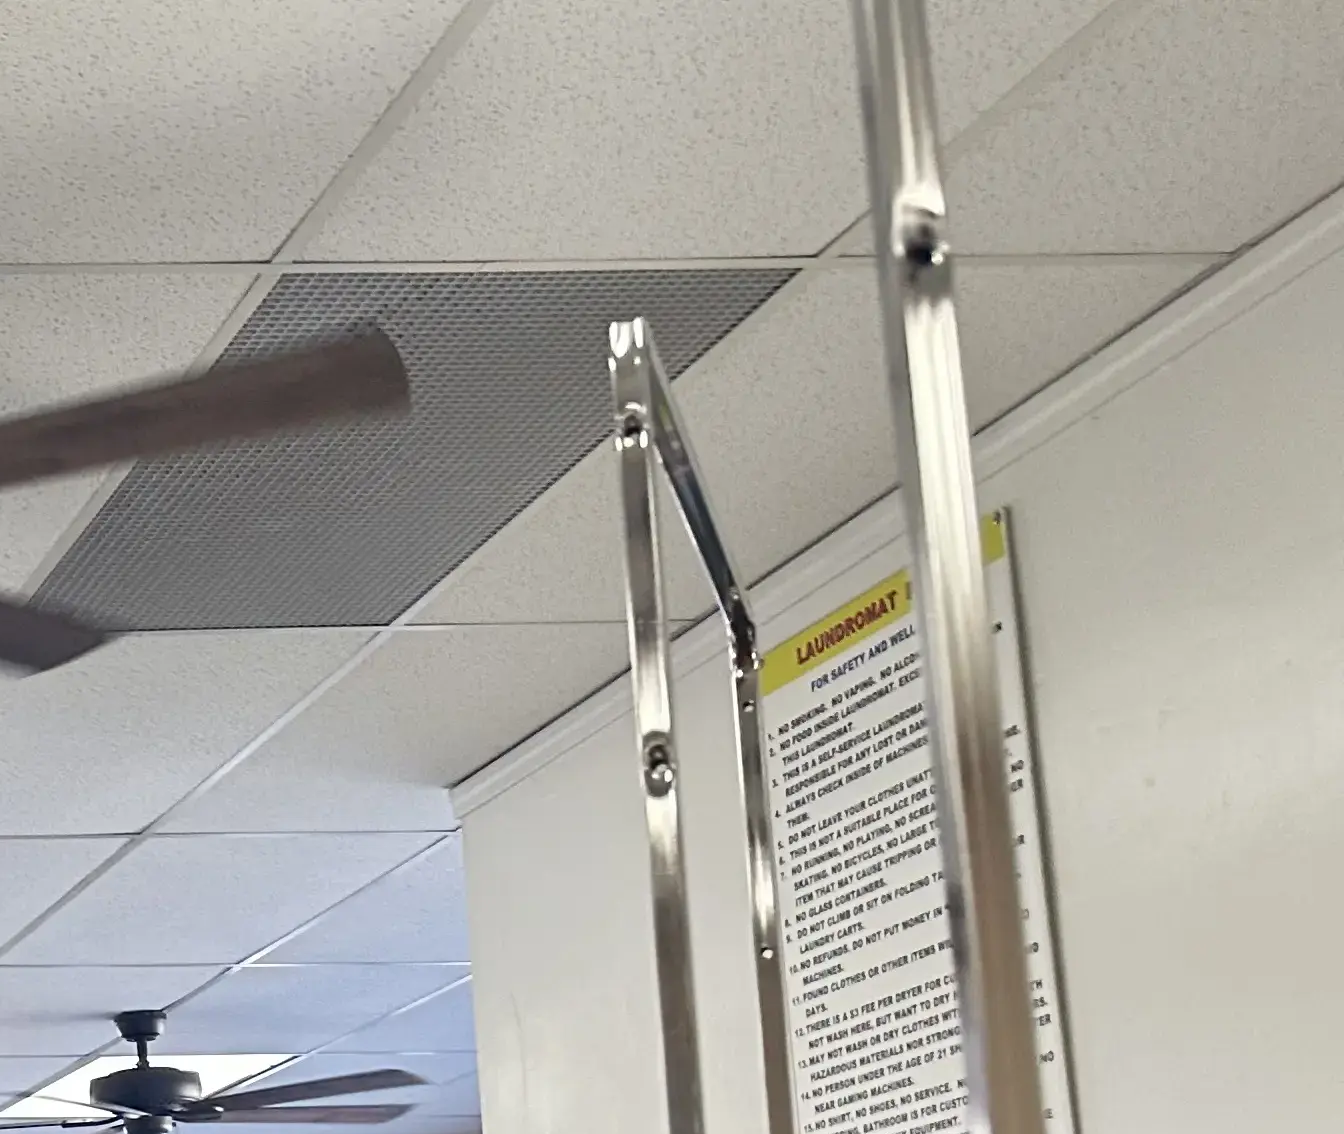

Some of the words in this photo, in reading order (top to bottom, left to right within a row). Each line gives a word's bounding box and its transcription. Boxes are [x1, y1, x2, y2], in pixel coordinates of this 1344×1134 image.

[795, 587, 897, 667] LAUNDROMAT
[810, 672, 830, 694] FOR
[830, 650, 865, 683] SAFETY
[867, 637, 888, 661] AND
[777, 721, 790, 739] NO
[830, 690, 843, 709] NO
[879, 662, 892, 682] NO
[779, 737, 791, 754] NO
[782, 765, 800, 785] THIS
[801, 760, 809, 775] IS
[810, 756, 817, 770] A
[817, 726, 871, 766] SELF-SERVICE
[782, 749, 800, 768] THIS
[836, 753, 854, 773] FOR
[854, 744, 871, 764] ANY
[872, 732, 894, 754] LOST
[894, 724, 907, 743] OR
[785, 789, 816, 816] ALWAYS
[816, 775, 843, 800] CHECK
[872, 754, 884, 771] OF
[788, 832, 799, 847] DO
[800, 823, 816, 841] NOT
[817, 810, 843, 832] LEAVE
[843, 798, 866, 819] YOUR
[867, 779, 904, 808] CLOTHES
[790, 844, 807, 862] THIS
[808, 839, 817, 853] IS
[817, 831, 834, 849] NOT
[835, 827, 842, 840] A
[842, 808, 881, 837] SUITABLE
[882, 794, 909, 818] PLACE
[910, 785, 928, 805] FOR
[791, 863, 802, 878] NO
[842, 838, 855, 854] NO
[893, 813, 907, 830] NO
[830, 861, 843, 877] NO
[885, 835, 899, 851] NO
[899, 822, 927, 845] LARGE
[795, 891, 814, 909] ITEM
[815, 881, 835, 900] THAT
[836, 872, 854, 890] MAY
[855, 860, 882, 882] CAUSE
[883, 842, 922, 869] TRIPPING
[923, 835, 936, 852] OR
[795, 910, 807, 925] NO
[807, 898, 833, 920] GLASS
[796, 926, 808, 941] DO
[809, 919, 825, 936] NOT
[826, 907, 851, 928] CLIMB
[852, 902, 864, 918] OR
[865, 895, 879, 912] SIT
[880, 890, 892, 906] ON
[893, 873, 930, 900] FOLDING
[799, 931, 835, 957] LAUNDRY
[836, 919, 864, 941] CARTS.
[799, 958, 811, 973] NO
[851, 936, 864, 952] DO
[865, 929, 881, 946] NOT
[883, 921, 900, 939] PUT
[901, 909, 931, 932] MONEY
[932, 904, 943, 919] IN
[802, 984, 829, 1005] FOUND
[830, 969, 866, 994] CLOTHES
[867, 964, 879, 980] OR
[880, 953, 909, 975] OTHER
[909, 942, 936, 963] ITEMS
[802, 961, 844, 988] MACHINES.
[805, 1016, 831, 1036] THERE
[832, 1013, 840, 1026] IS
[841, 1010, 848, 1023] A
[860, 1000, 876, 1016] FEE
[876, 993, 893, 1010] PER
[894, 983, 923, 1004] DRYER
[923, 976, 941, 993] FOR
[808, 1036, 824, 1052] NOT
[825, 1027, 849, 1046] WASH
[875, 1012, 892, 1029] BUT
[893, 1003, 917, 1022] WANT
[919, 998, 931, 1013] TO
[932, 991, 950, 1008] DRY
[808, 1052, 825, 1068] MAY
[827, 1046, 843, 1062] NOT
[844, 1037, 868, 1056] WASH
[869, 1032, 881, 1047] OR
[882, 1026, 899, 1043] DRY
[901, 1012, 940, 1037] CLOTHES
[810, 1058, 857, 1084] HAZARDOUS
[858, 1043, 904, 1068] MATERIALS
[905, 1036, 924, 1053] NOR
[811, 1086, 823, 1100] NO
[824, 1076, 856, 1096] PERSON
[857, 1066, 885, 1085] UNDER
[887, 1060, 903, 1076] THE
[904, 1054, 922, 1070] AGE
[923, 1050, 935, 1064] OF
[936, 1046, 947, 1060] 21
[814, 1098, 835, 1116] NEAR
[836, 1088, 868, 1109] GAMING
[869, 1074, 914, 1098] MACHINES.
[814, 1118, 826, 1131] NO
[854, 1106, 867, 1119] NO
[899, 1092, 912, 1106] NO
[862, 1111, 908, 1134] BATHROOM
[909, 1108, 919, 1121] IS
[919, 1103, 938, 1118] FOR
